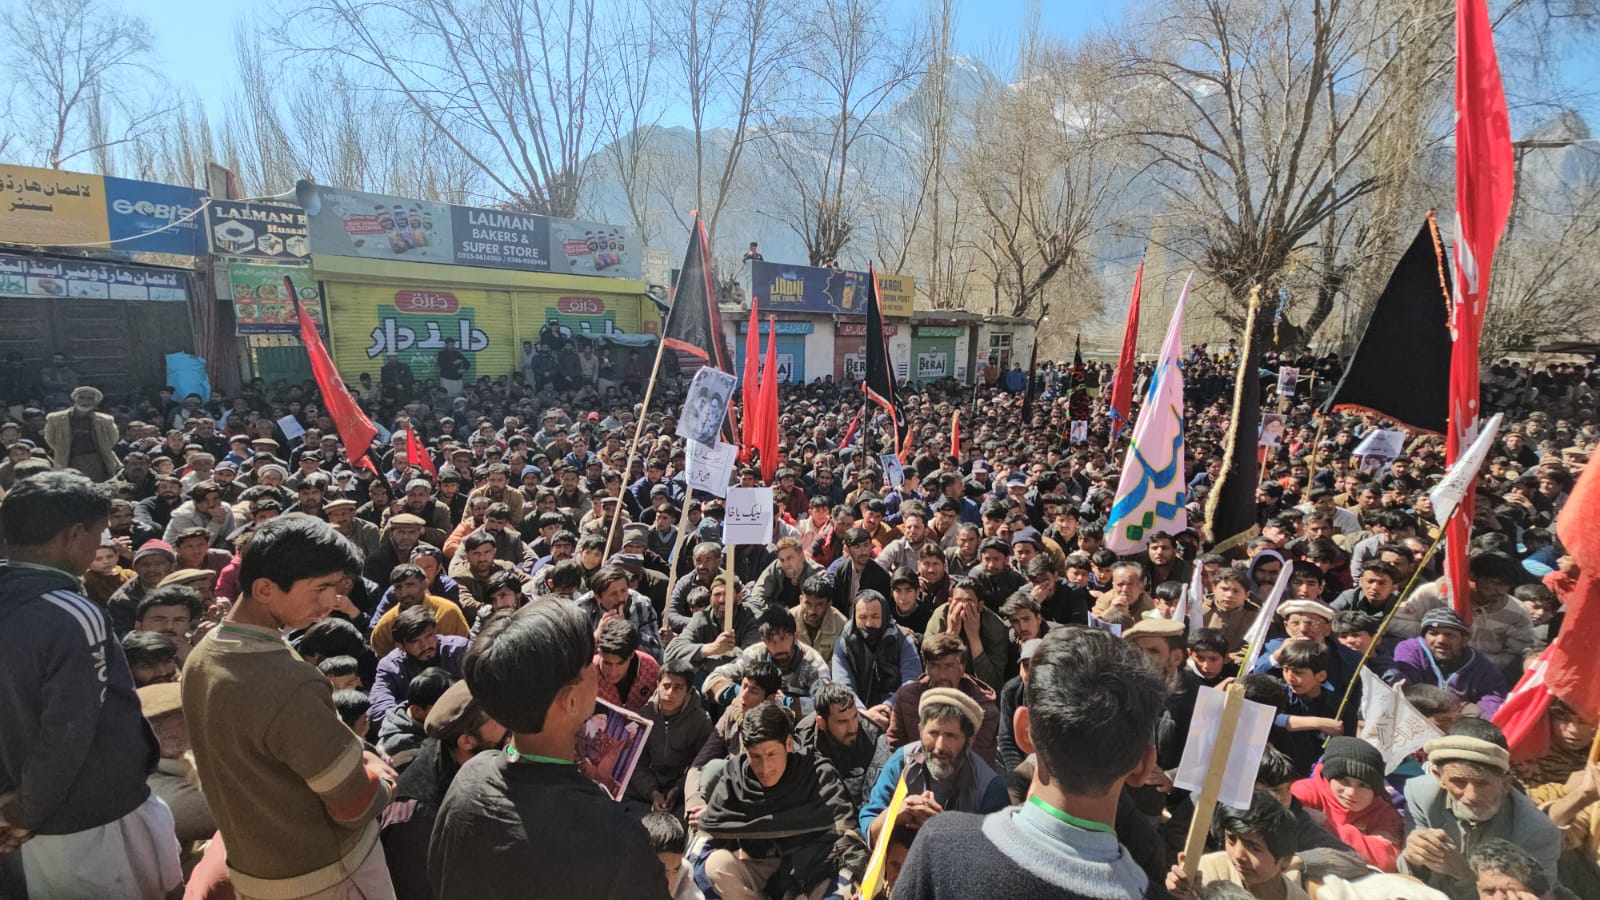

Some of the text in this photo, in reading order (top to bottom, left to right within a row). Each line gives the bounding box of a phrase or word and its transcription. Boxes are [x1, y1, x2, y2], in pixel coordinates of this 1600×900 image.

[215, 206, 294, 224] LALMAN
[468, 211, 535, 232] LALMAN
[472, 228, 529, 245] BAKERS &
[462, 241, 539, 258] SUPER STORE
[846, 358, 866, 372] BER
[919, 356, 946, 373] BERAJ
[742, 503, 762, 521] لبیک
